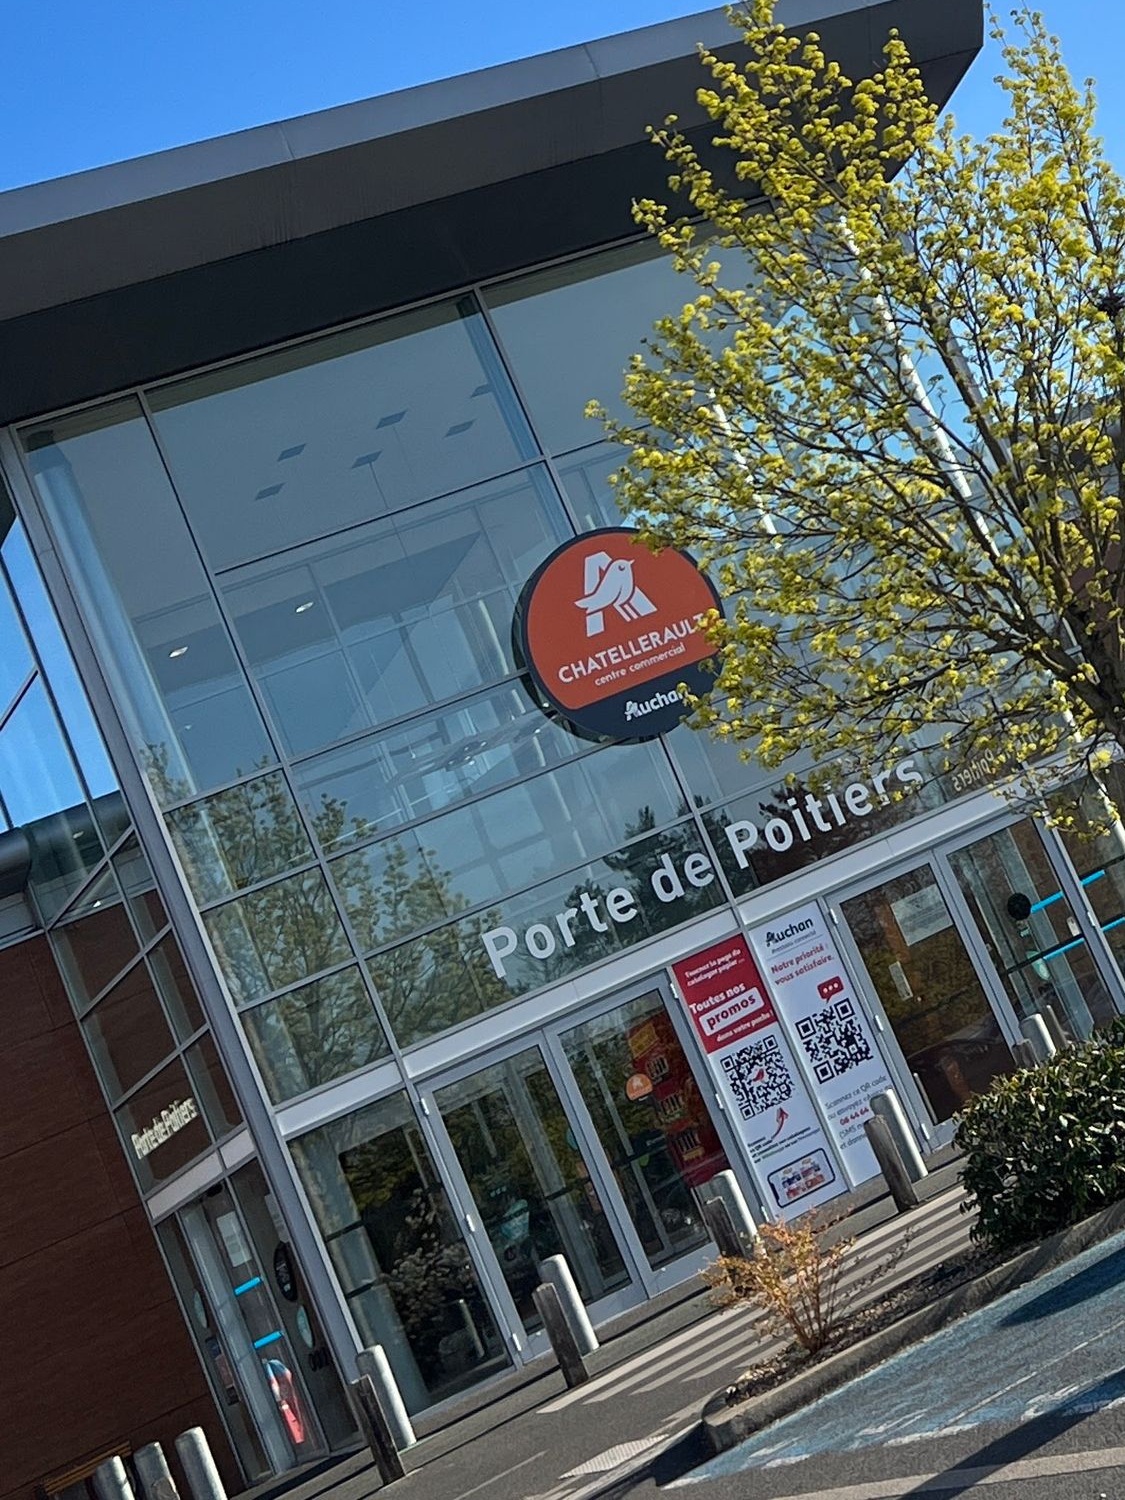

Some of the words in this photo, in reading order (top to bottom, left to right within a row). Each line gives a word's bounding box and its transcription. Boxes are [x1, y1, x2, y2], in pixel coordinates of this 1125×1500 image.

[595, 668, 627, 686] centre
[629, 642, 686, 673] commercial
[481, 886, 639, 979] Porte
[650, 849, 716, 903] de
[724, 758, 925, 869] Poitiers
[766, 918, 813, 947] Auchan
[770, 960, 795, 974] Notre
[775, 973, 794, 985] vous
[689, 991, 727, 1014] Toutes
[725, 982, 746, 998] nos
[706, 994, 756, 1030] promos
